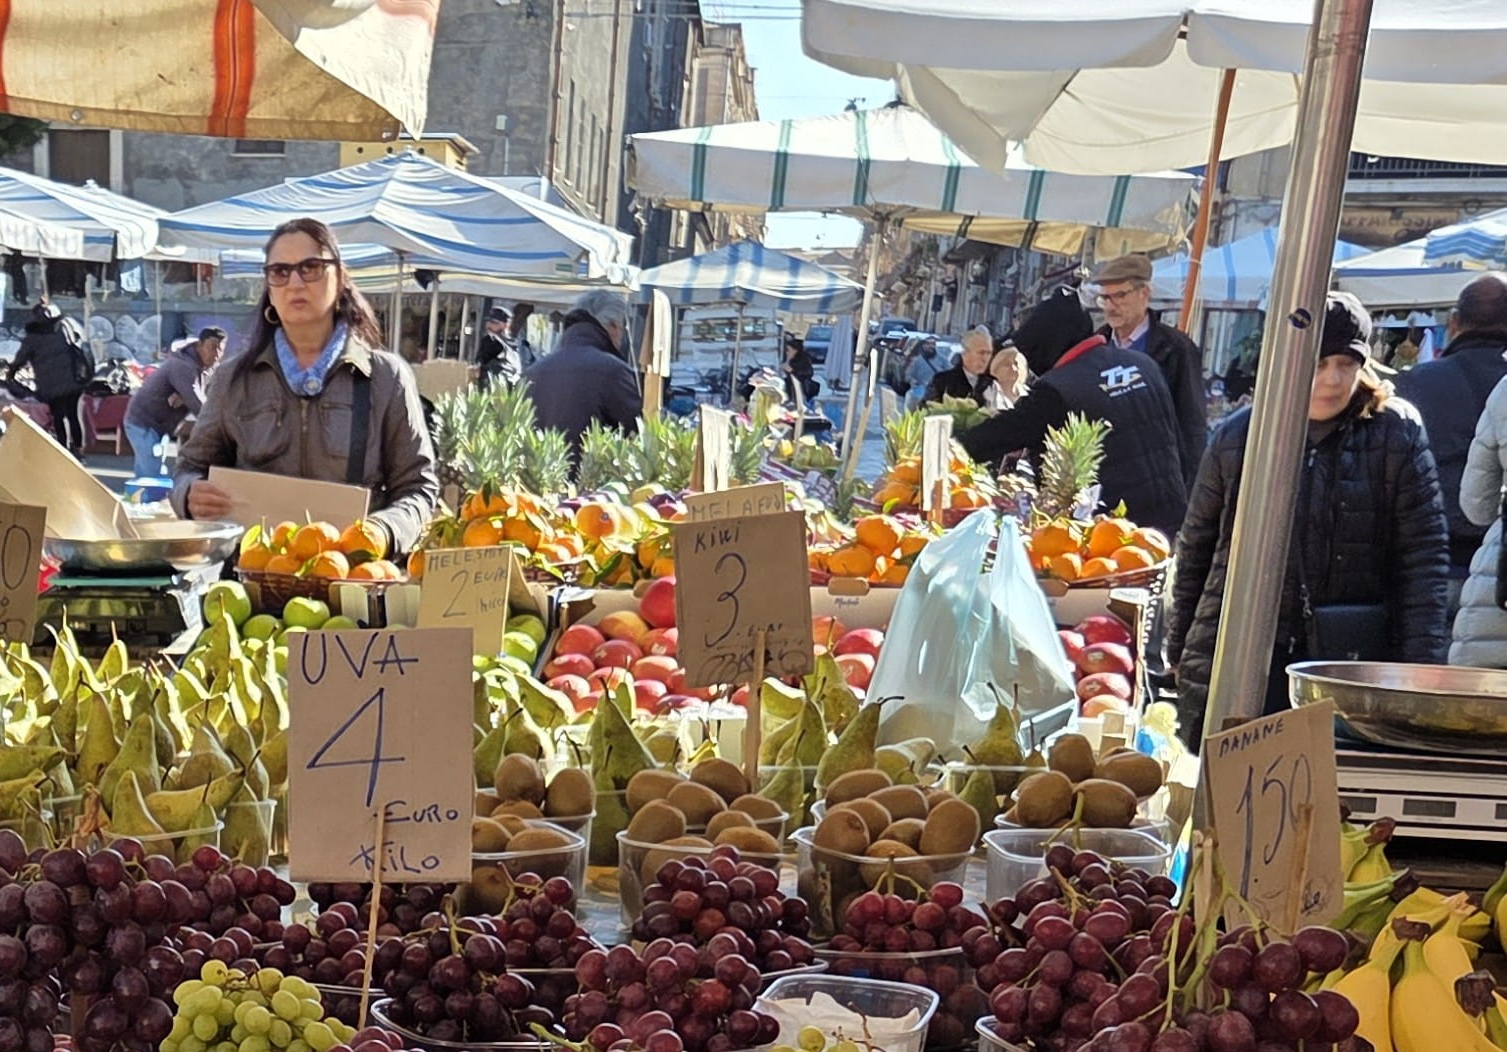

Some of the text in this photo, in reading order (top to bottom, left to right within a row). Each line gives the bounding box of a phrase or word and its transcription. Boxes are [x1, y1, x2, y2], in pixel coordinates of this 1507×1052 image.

[442, 569, 469, 618] 2
[704, 553, 747, 648] 3
[301, 631, 419, 685] UVA
[306, 687, 406, 807] 4
[1219, 718, 1285, 758] BANANE
